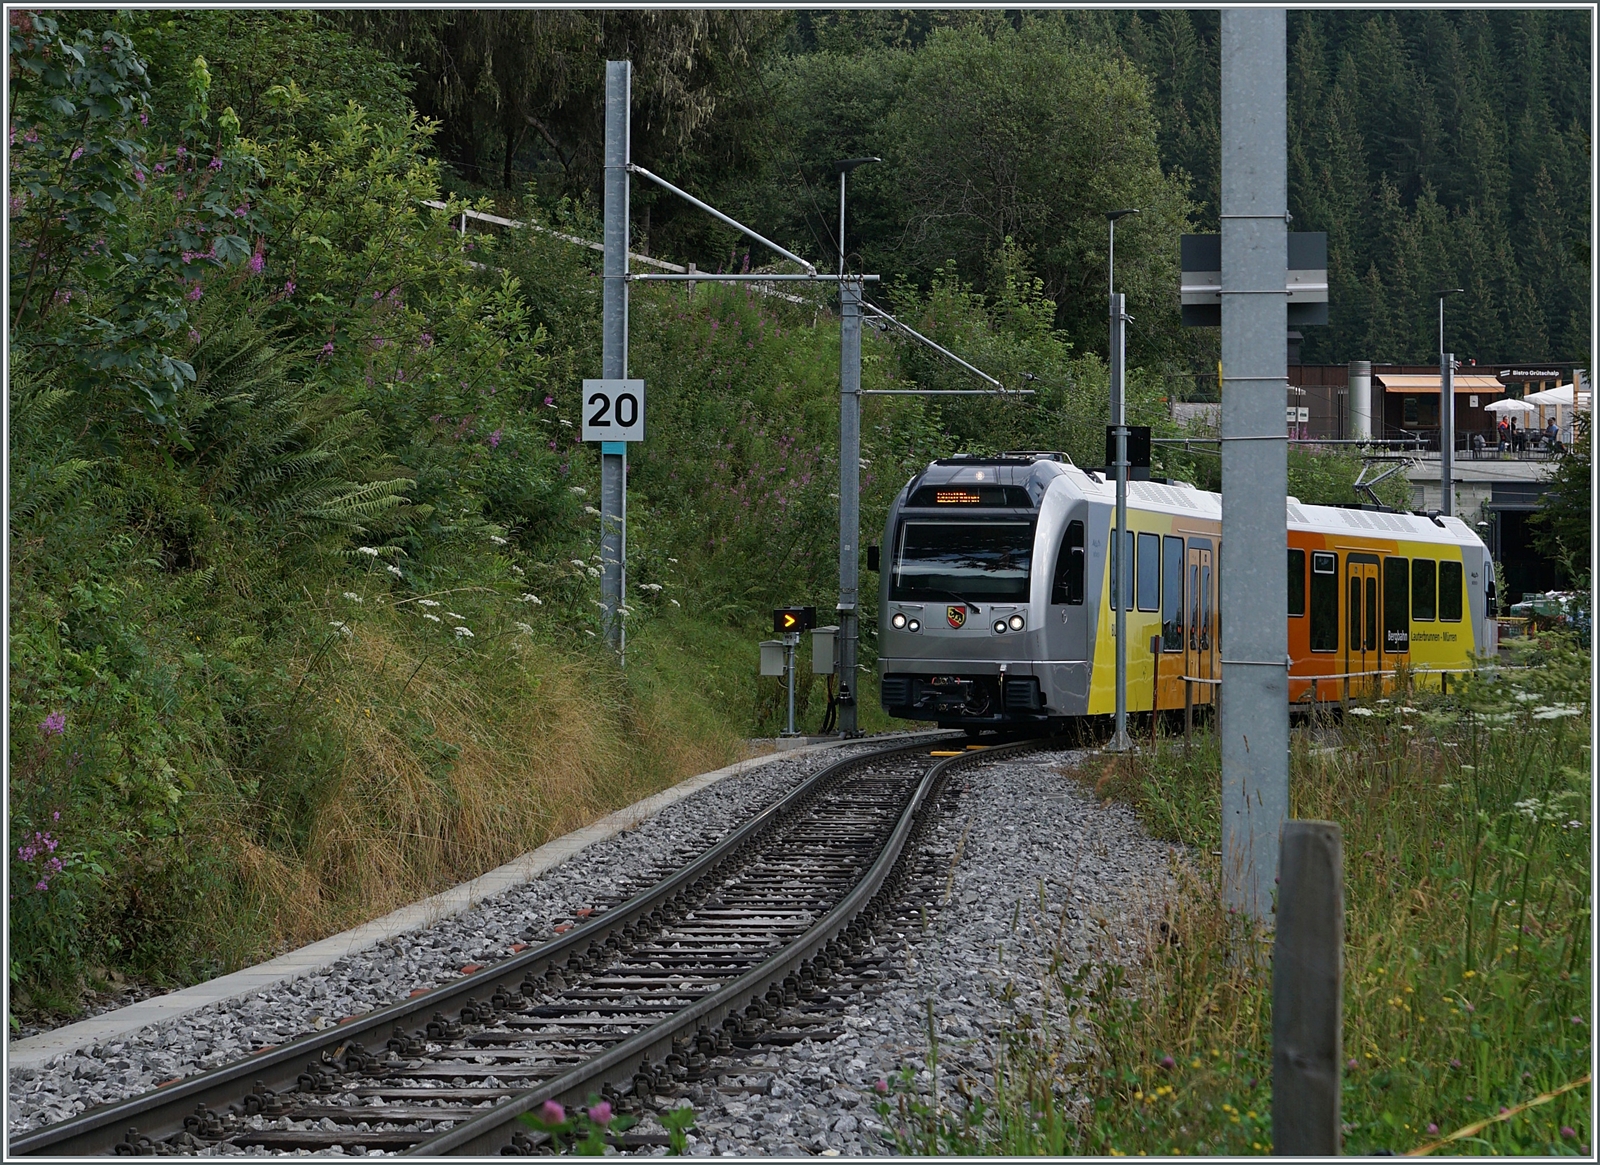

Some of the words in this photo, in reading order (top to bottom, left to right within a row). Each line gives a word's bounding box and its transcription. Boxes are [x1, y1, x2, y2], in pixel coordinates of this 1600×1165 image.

[588, 392, 638, 428] 20
[1388, 629, 1408, 644] Bergbahn
[1411, 631, 1440, 642] Lauterbrunnen
[1443, 631, 1457, 642] Mürren
